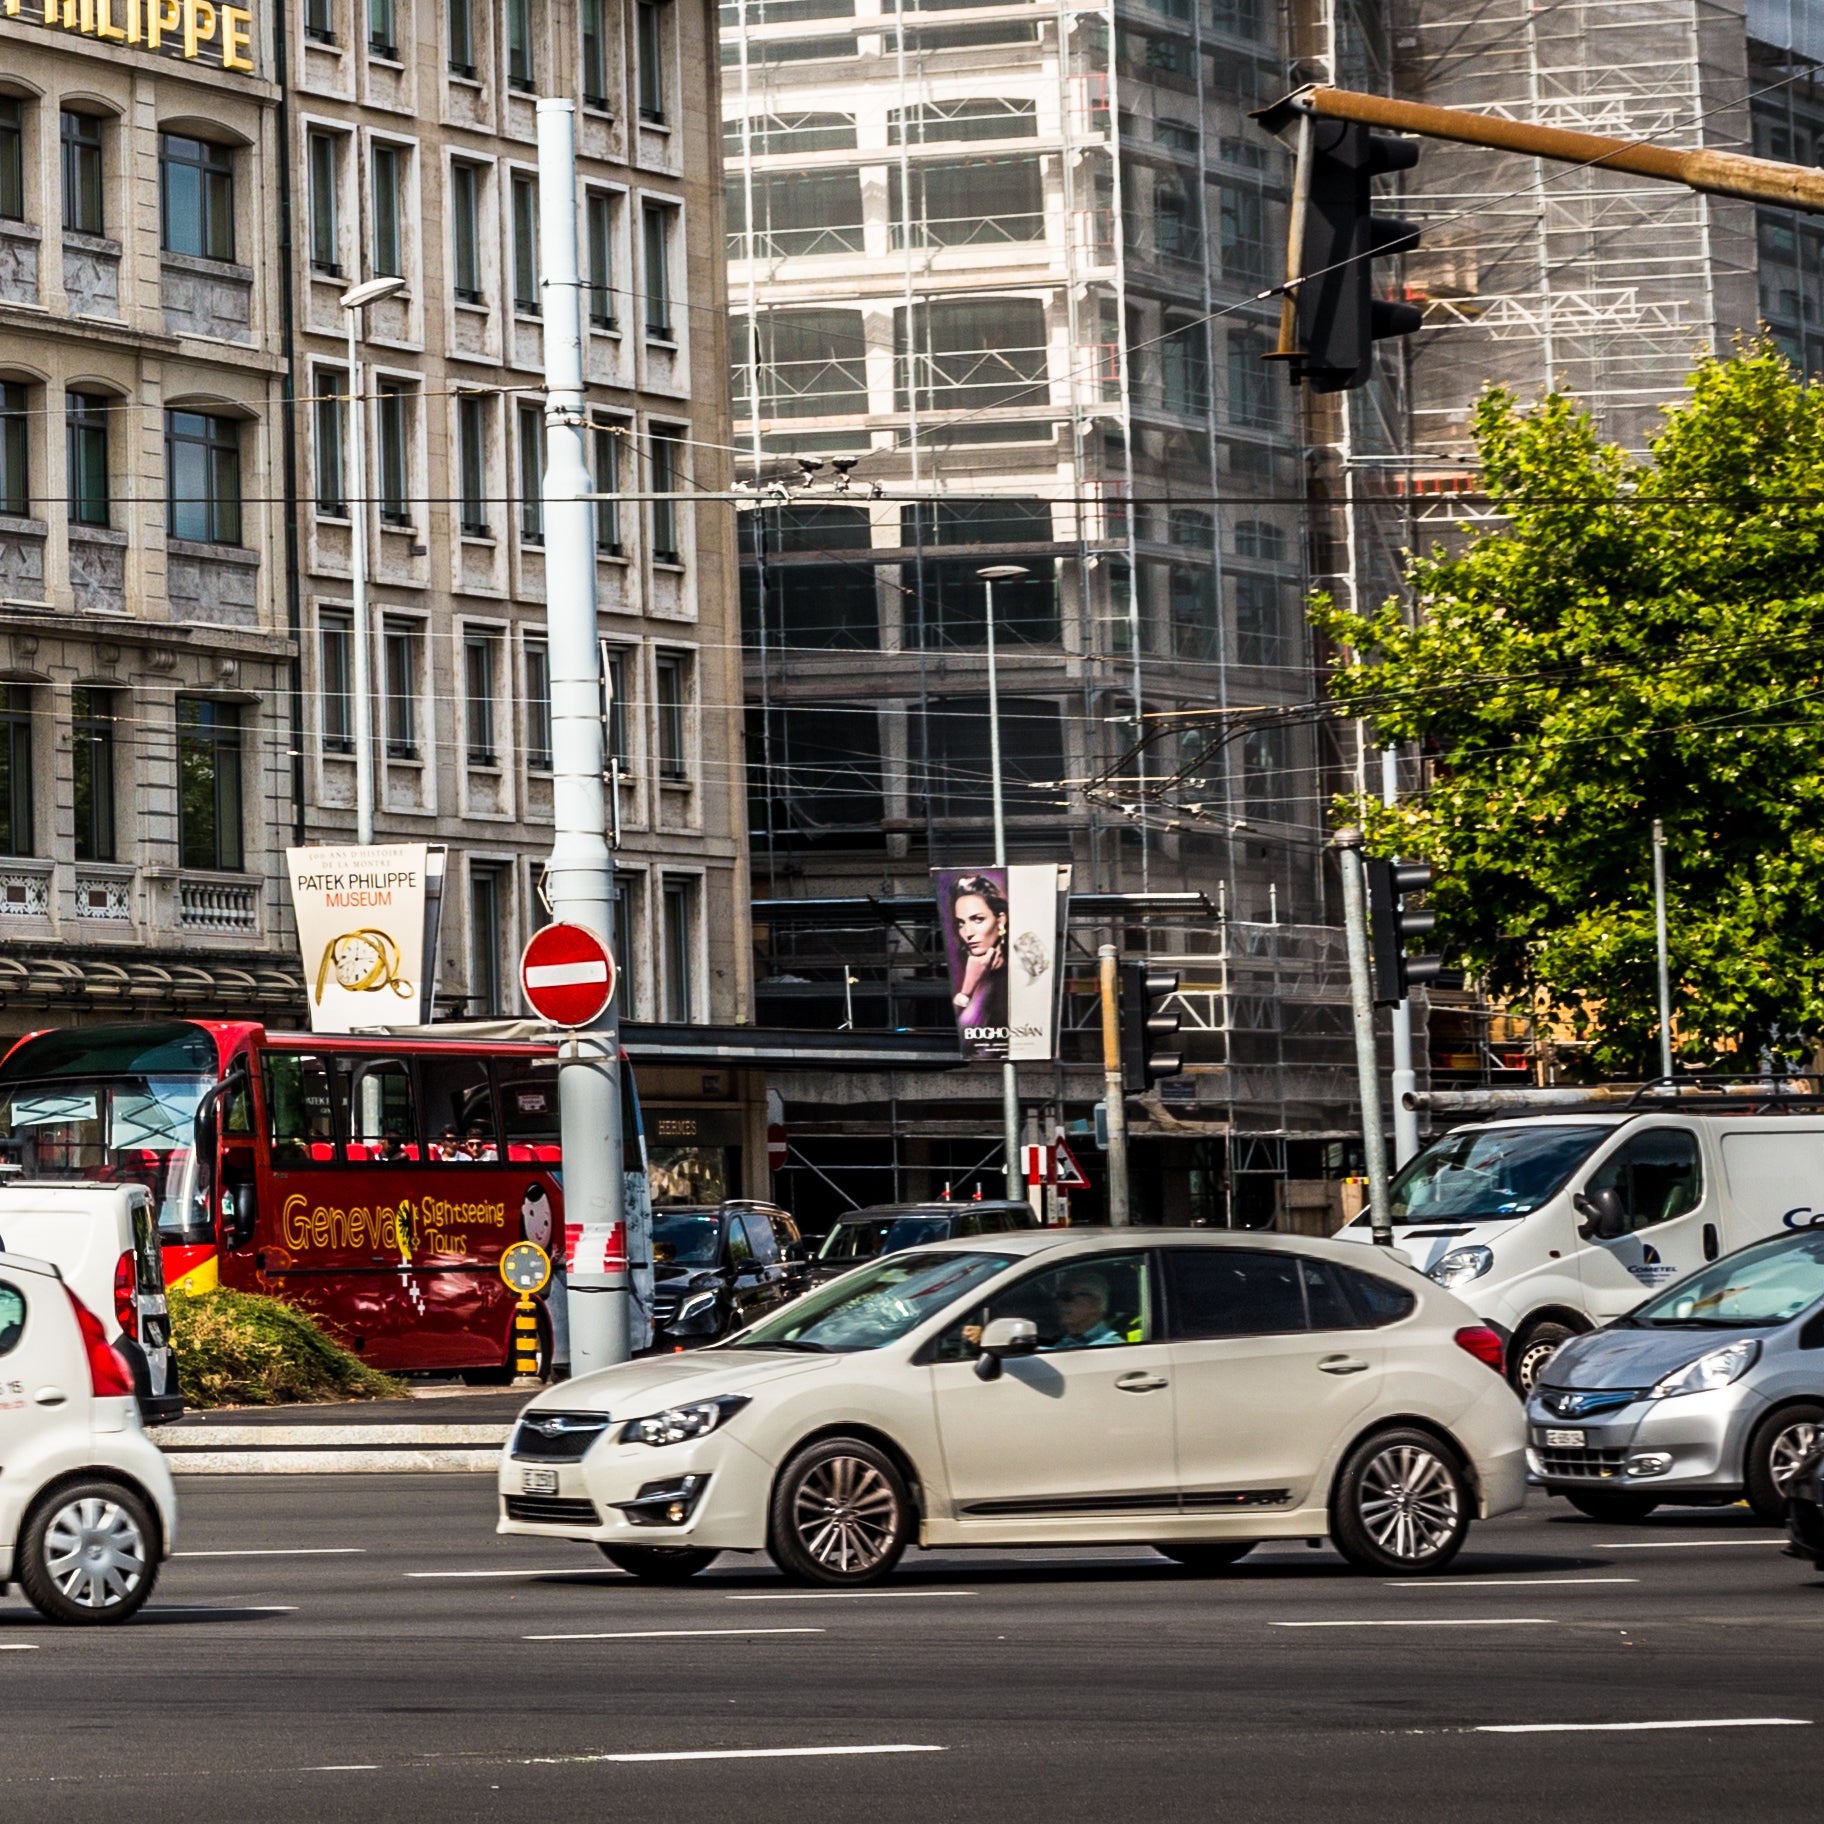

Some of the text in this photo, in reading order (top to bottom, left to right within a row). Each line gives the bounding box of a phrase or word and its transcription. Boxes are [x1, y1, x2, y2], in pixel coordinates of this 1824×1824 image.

[354, 859, 391, 868] MONTRE
[298, 871, 417, 891] PATEK PHILIPPE
[326, 891, 392, 908] MUSEUM
[283, 1193, 505, 1251] Geneva Sightseeing
[424, 1228, 468, 1255] Tours
